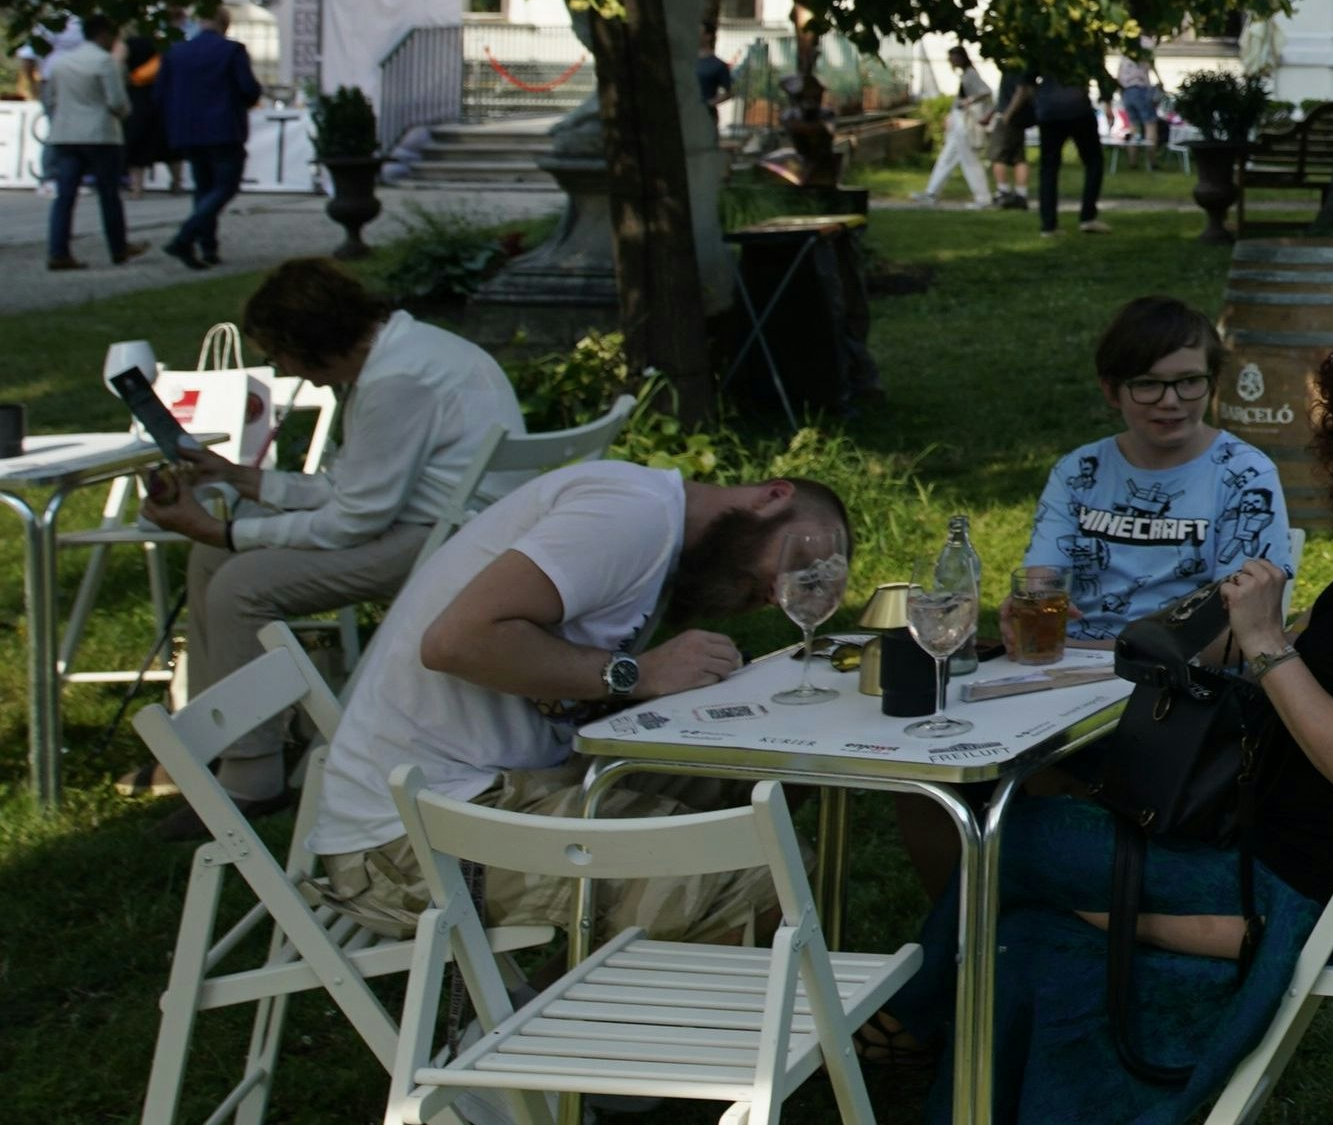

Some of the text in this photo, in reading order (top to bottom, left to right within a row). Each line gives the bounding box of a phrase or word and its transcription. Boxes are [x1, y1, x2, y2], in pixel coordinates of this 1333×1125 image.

[1079, 506, 1209, 542] MINECRAFT
[758, 736, 817, 747] KURIER
[929, 746, 1012, 764] FREILUFT
